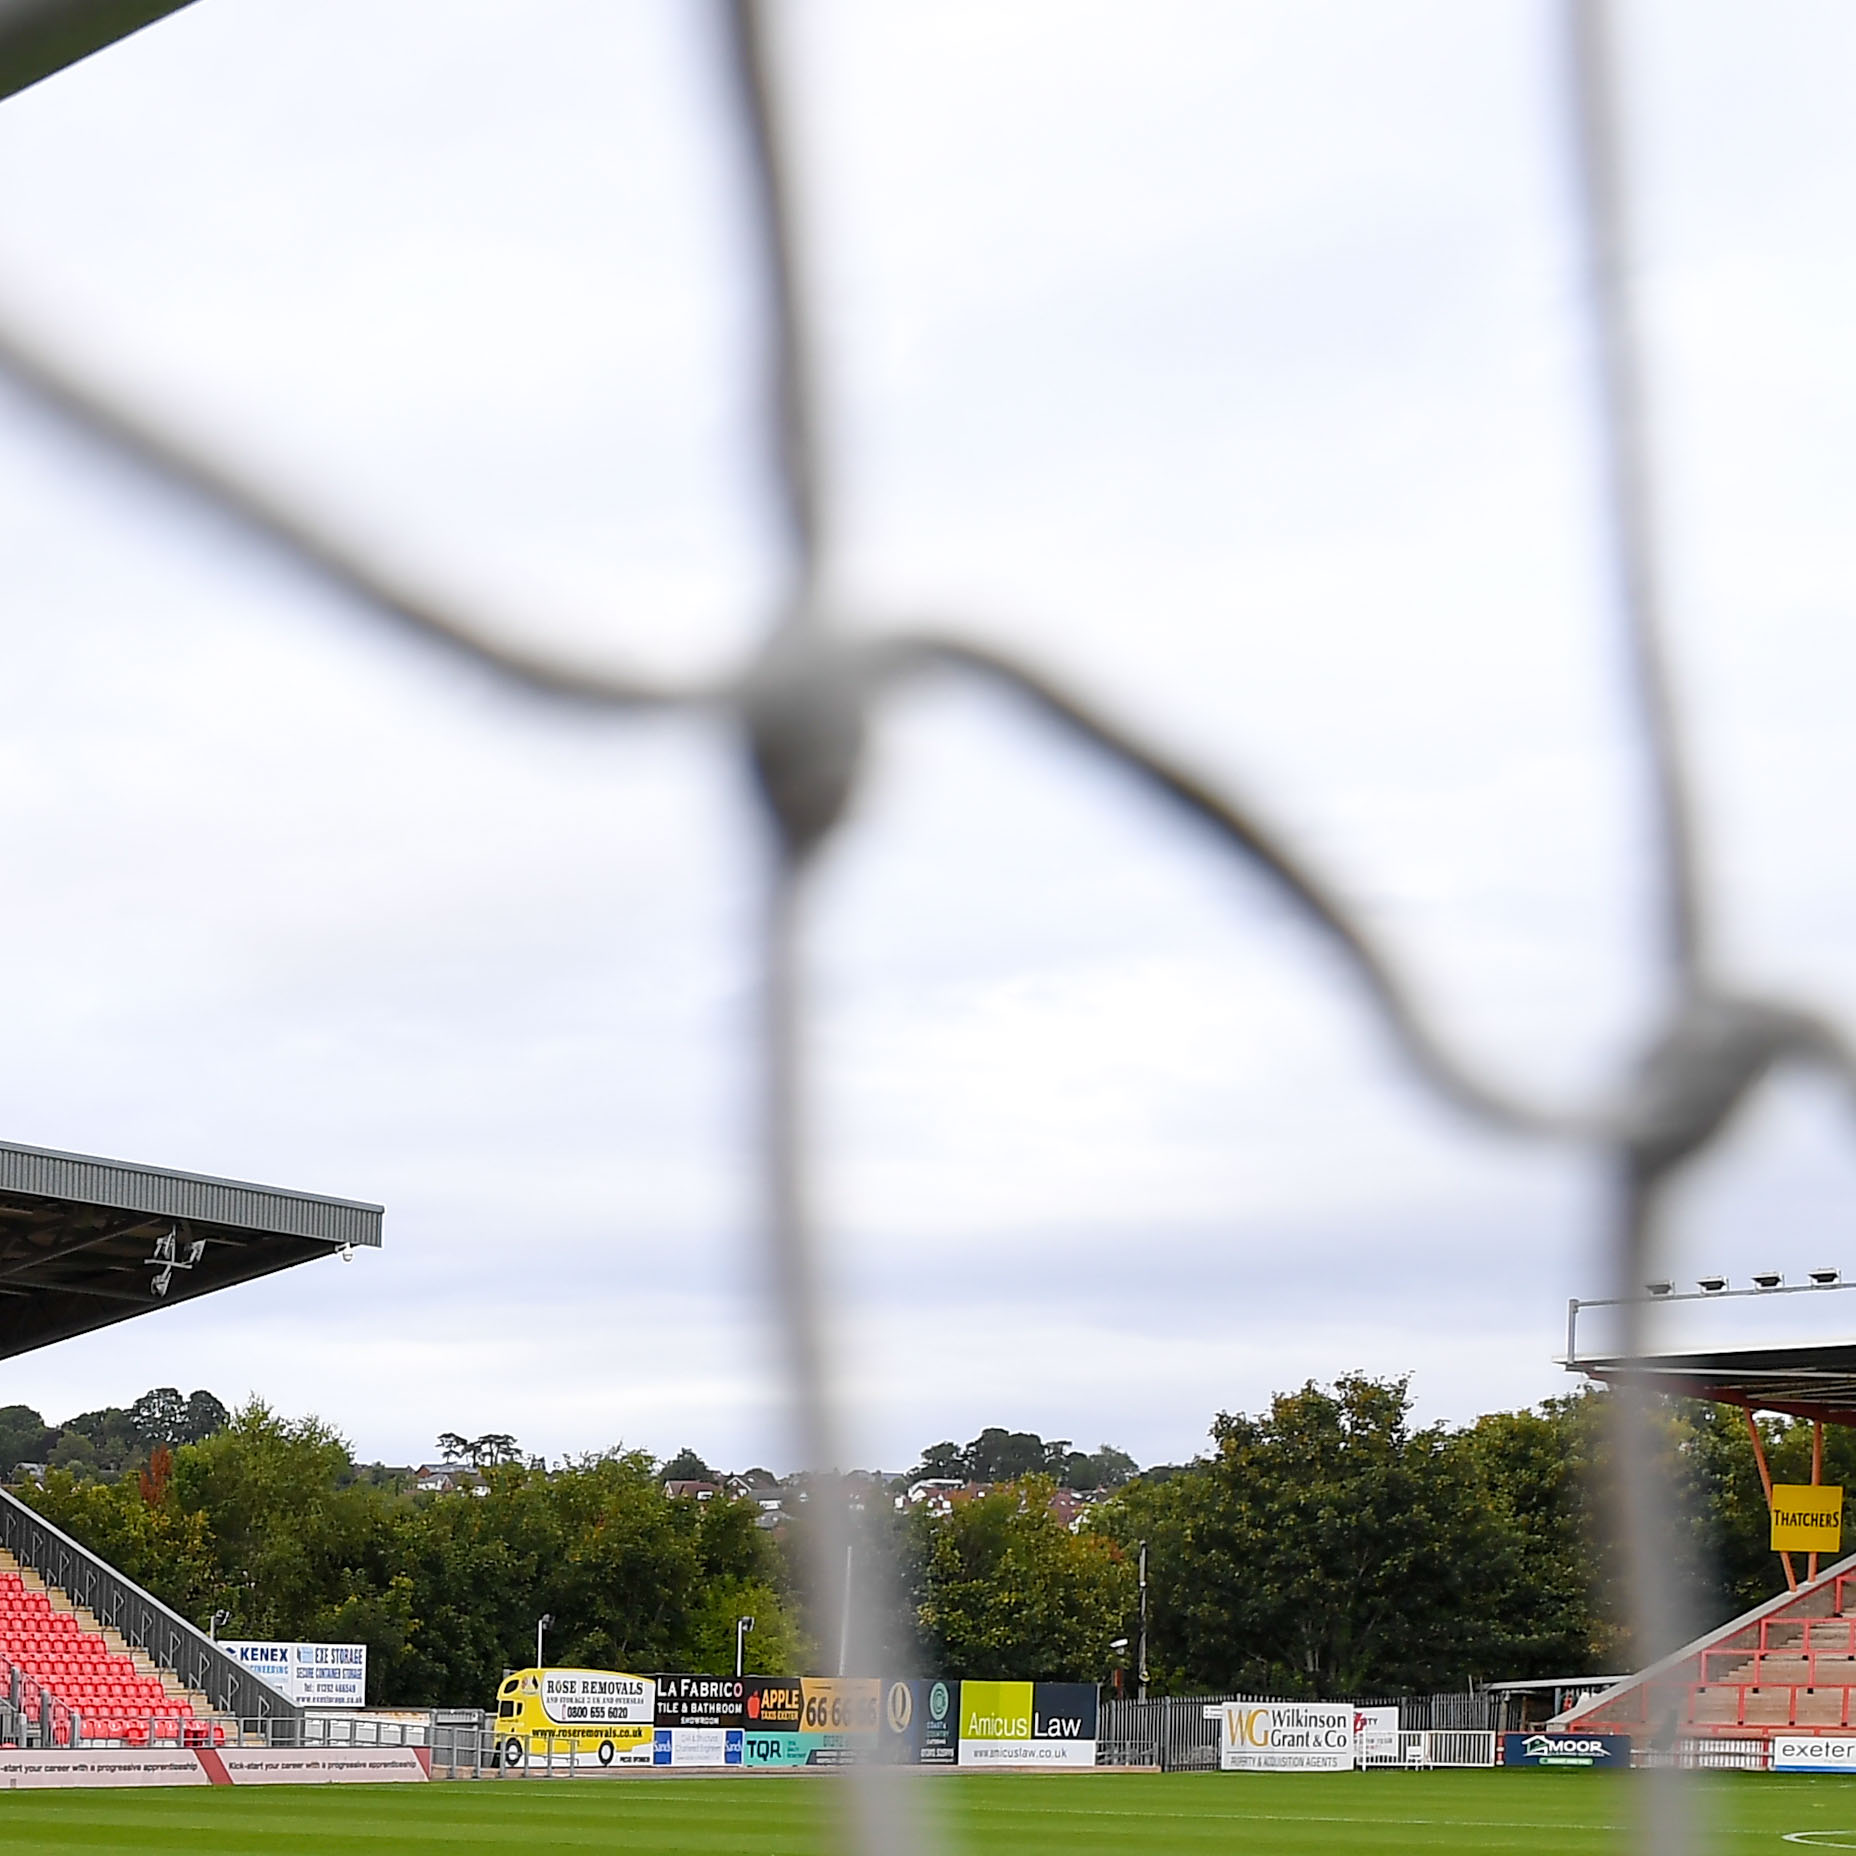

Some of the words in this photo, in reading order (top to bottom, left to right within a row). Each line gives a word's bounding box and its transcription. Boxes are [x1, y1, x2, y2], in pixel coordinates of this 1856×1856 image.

[1775, 1509, 1839, 1528] THATCHERS
[240, 1647, 288, 1662] KENEX
[315, 1647, 329, 1664] EXE
[331, 1648, 363, 1664] STORAGE
[547, 1680, 577, 1694] ROSE
[582, 1681, 643, 1695] REMOVALS
[657, 1678, 677, 1697] LA
[681, 1679, 743, 1697] FABRICO
[657, 1703, 678, 1713] TILE
[681, 1703, 688, 1713] &
[691, 1703, 742, 1714] BATHROOM
[761, 1689, 799, 1709] APPLE
[590, 1707, 605, 1718] 655
[608, 1707, 628, 1718] 6020
[806, 1697, 827, 1727] 66
[1272, 1708, 1346, 1728] Wilkinson
[968, 1712, 1027, 1736] Amicus
[1034, 1712, 1081, 1737] Law
[1226, 1709, 1269, 1747] WG
[1271, 1729, 1309, 1748] Grant
[1313, 1737, 1322, 1747] &
[1325, 1730, 1347, 1748] Co
[1549, 1740, 1605, 1753] MOOR
[747, 1740, 781, 1761] TQR
[1782, 1742, 1855, 1758] exeter
